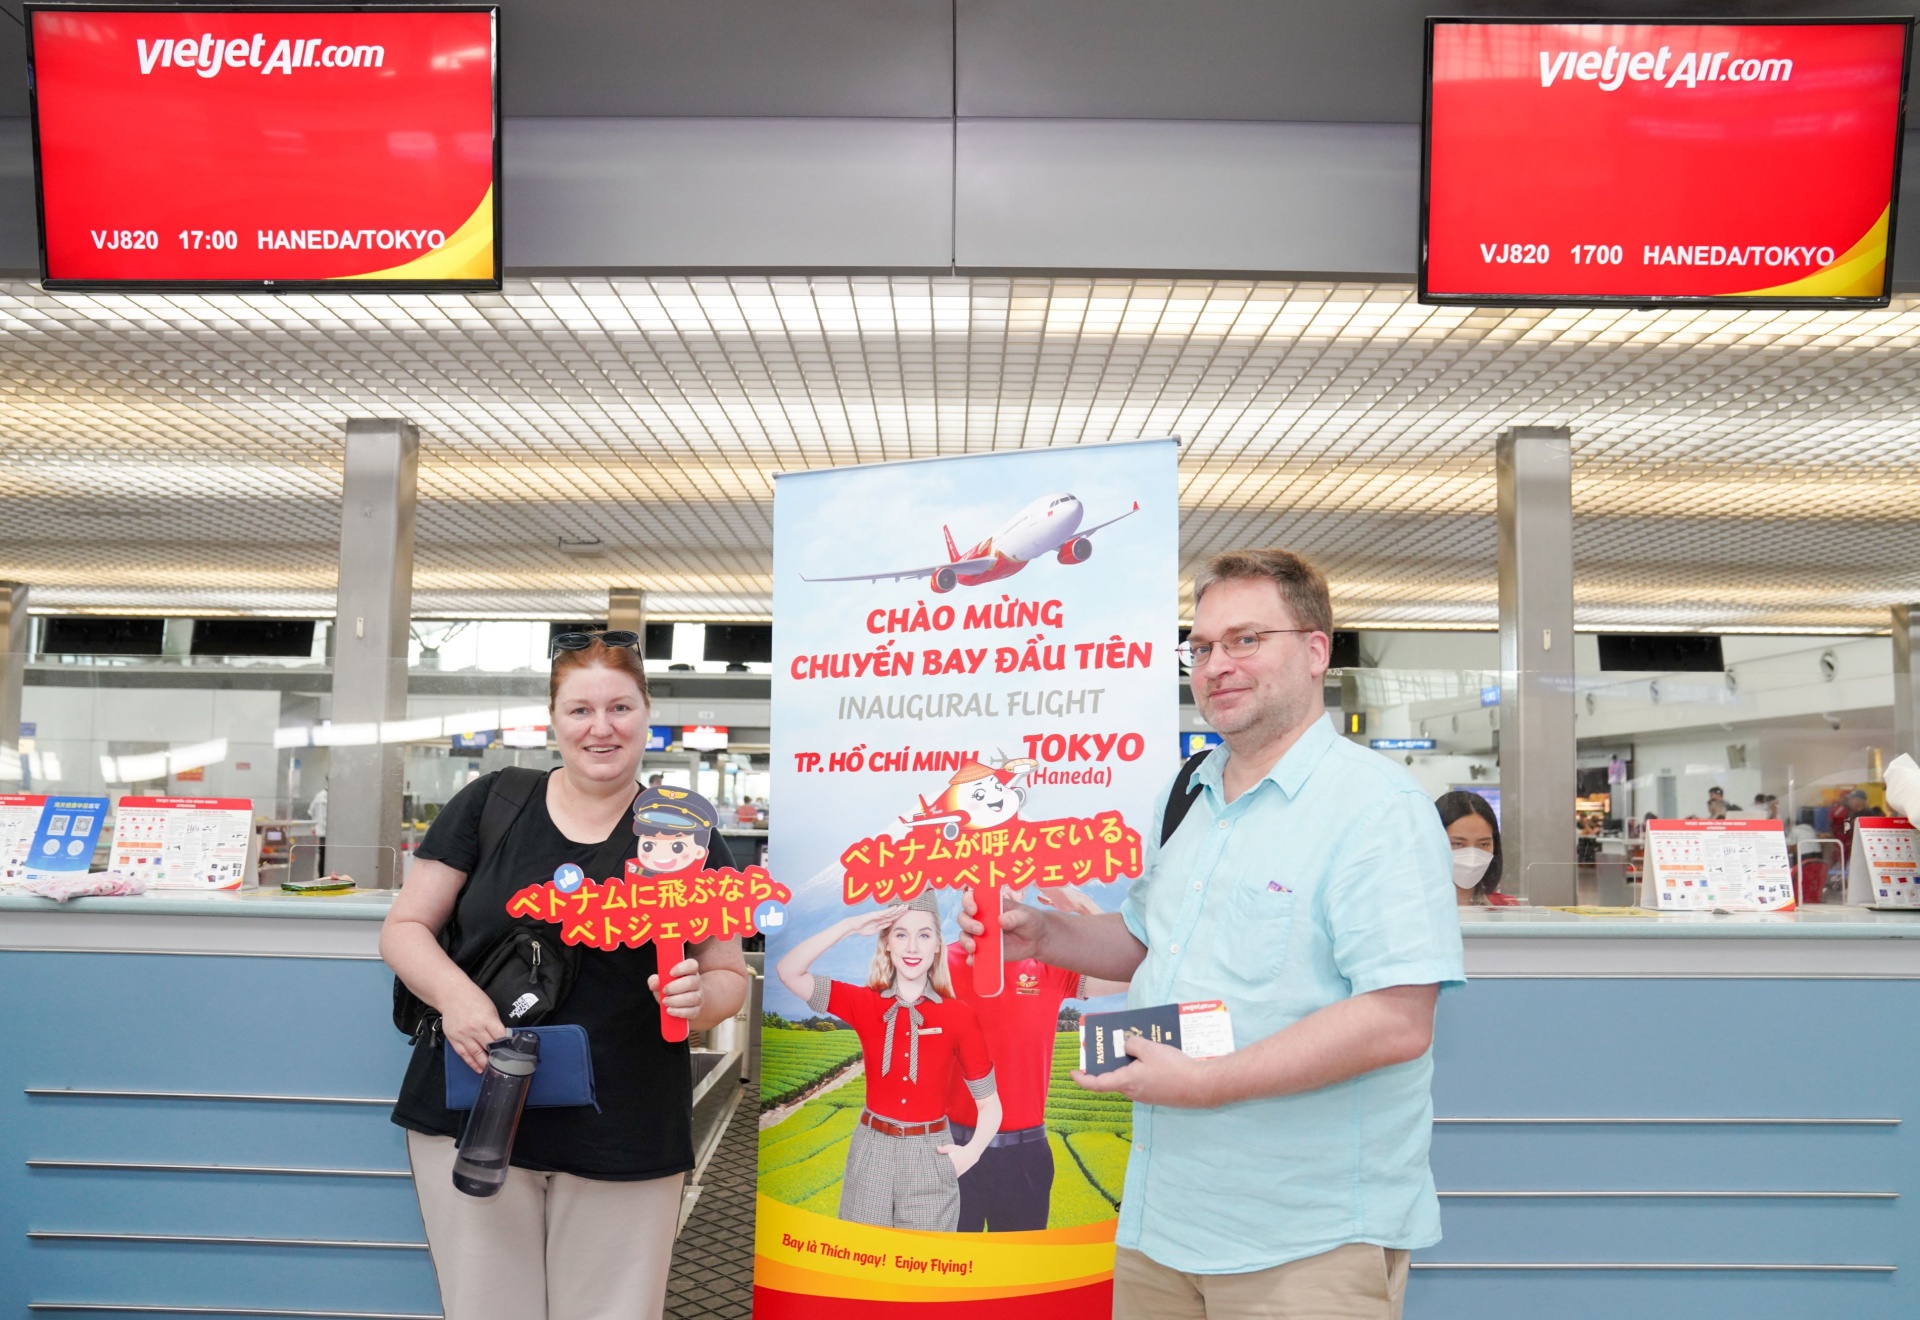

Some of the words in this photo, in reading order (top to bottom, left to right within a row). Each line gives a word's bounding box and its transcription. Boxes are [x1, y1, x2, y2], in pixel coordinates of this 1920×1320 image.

[91, 230, 159, 250] VJ820
[178, 230, 238, 250] 17:00
[257, 230, 445, 250] HANEDA/TOKYO
[1480, 244, 1550, 264] VJ820
[1570, 244, 1623, 265] 1700
[1643, 245, 1835, 266] HANEDA/TOKYO
[867, 600, 956, 635] CHÀO
[963, 594, 1063, 630] MỪNG
[790, 639, 916, 680] CHUYẾN
[922, 647, 989, 675] BAY
[994, 633, 1066, 673] ĐẦU
[1074, 634, 1153, 669] TIÊN
[838, 693, 999, 720] INAUGURAL
[1007, 688, 1105, 718] FLIGHT
[794, 751, 825, 773] TP.
[828, 743, 867, 773] HỒ
[868, 745, 910, 773] CHÍ
[1023, 732, 1145, 762] TOKYO
[1026, 766, 1112, 788] (Haneda)
[845, 816, 1138, 868] ベトナムが呼んでいる、
[512, 872, 786, 917] ベトナムに飛ぶなら、
[1096, 1026, 1104, 1064] PASSPORT
[781, 1233, 805, 1253] Bay
[806, 1240, 818, 1253] là
[820, 1242, 851, 1260] Thích
[894, 1255, 928, 1274] Enjoy
